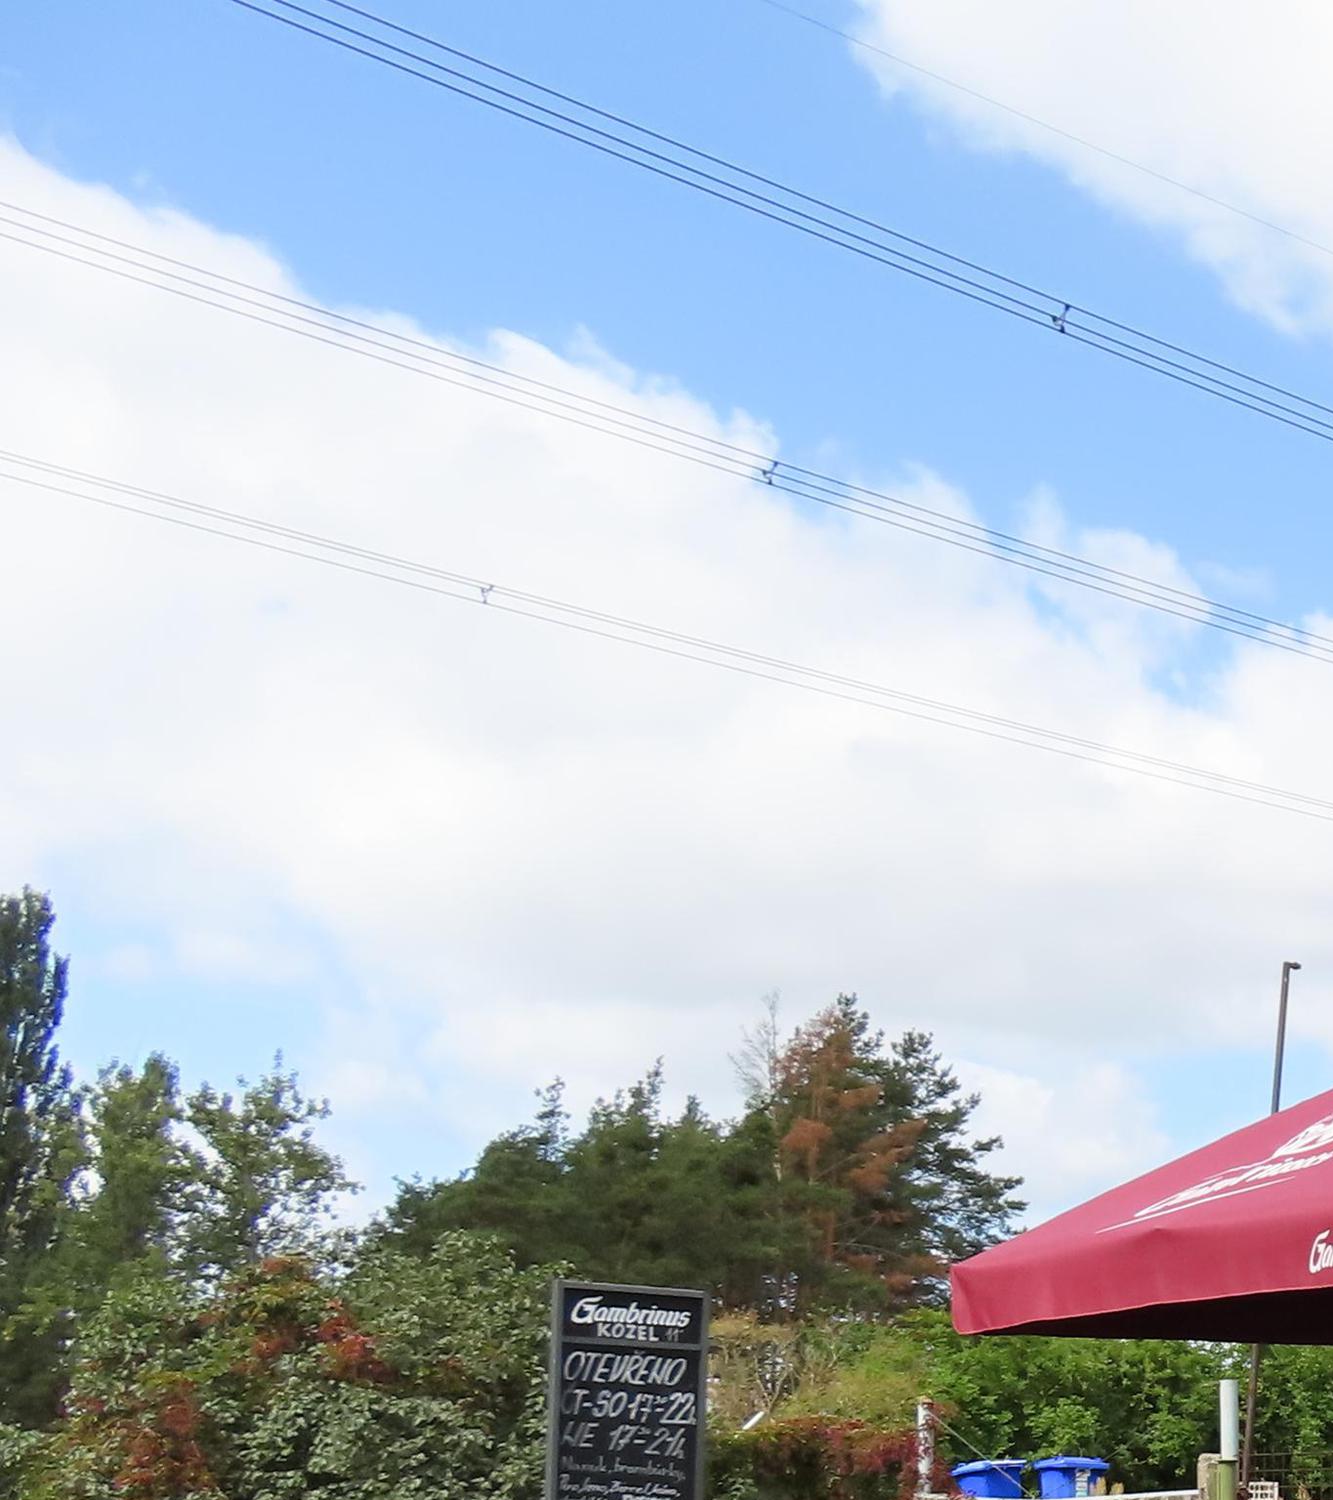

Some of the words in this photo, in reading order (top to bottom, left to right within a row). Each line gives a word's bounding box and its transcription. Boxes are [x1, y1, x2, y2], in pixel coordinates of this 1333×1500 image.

[571, 1295, 692, 1327] Gambrinus
[597, 1323, 660, 1342] KOZEL
[564, 1350, 688, 1386] OTEVŘENO
